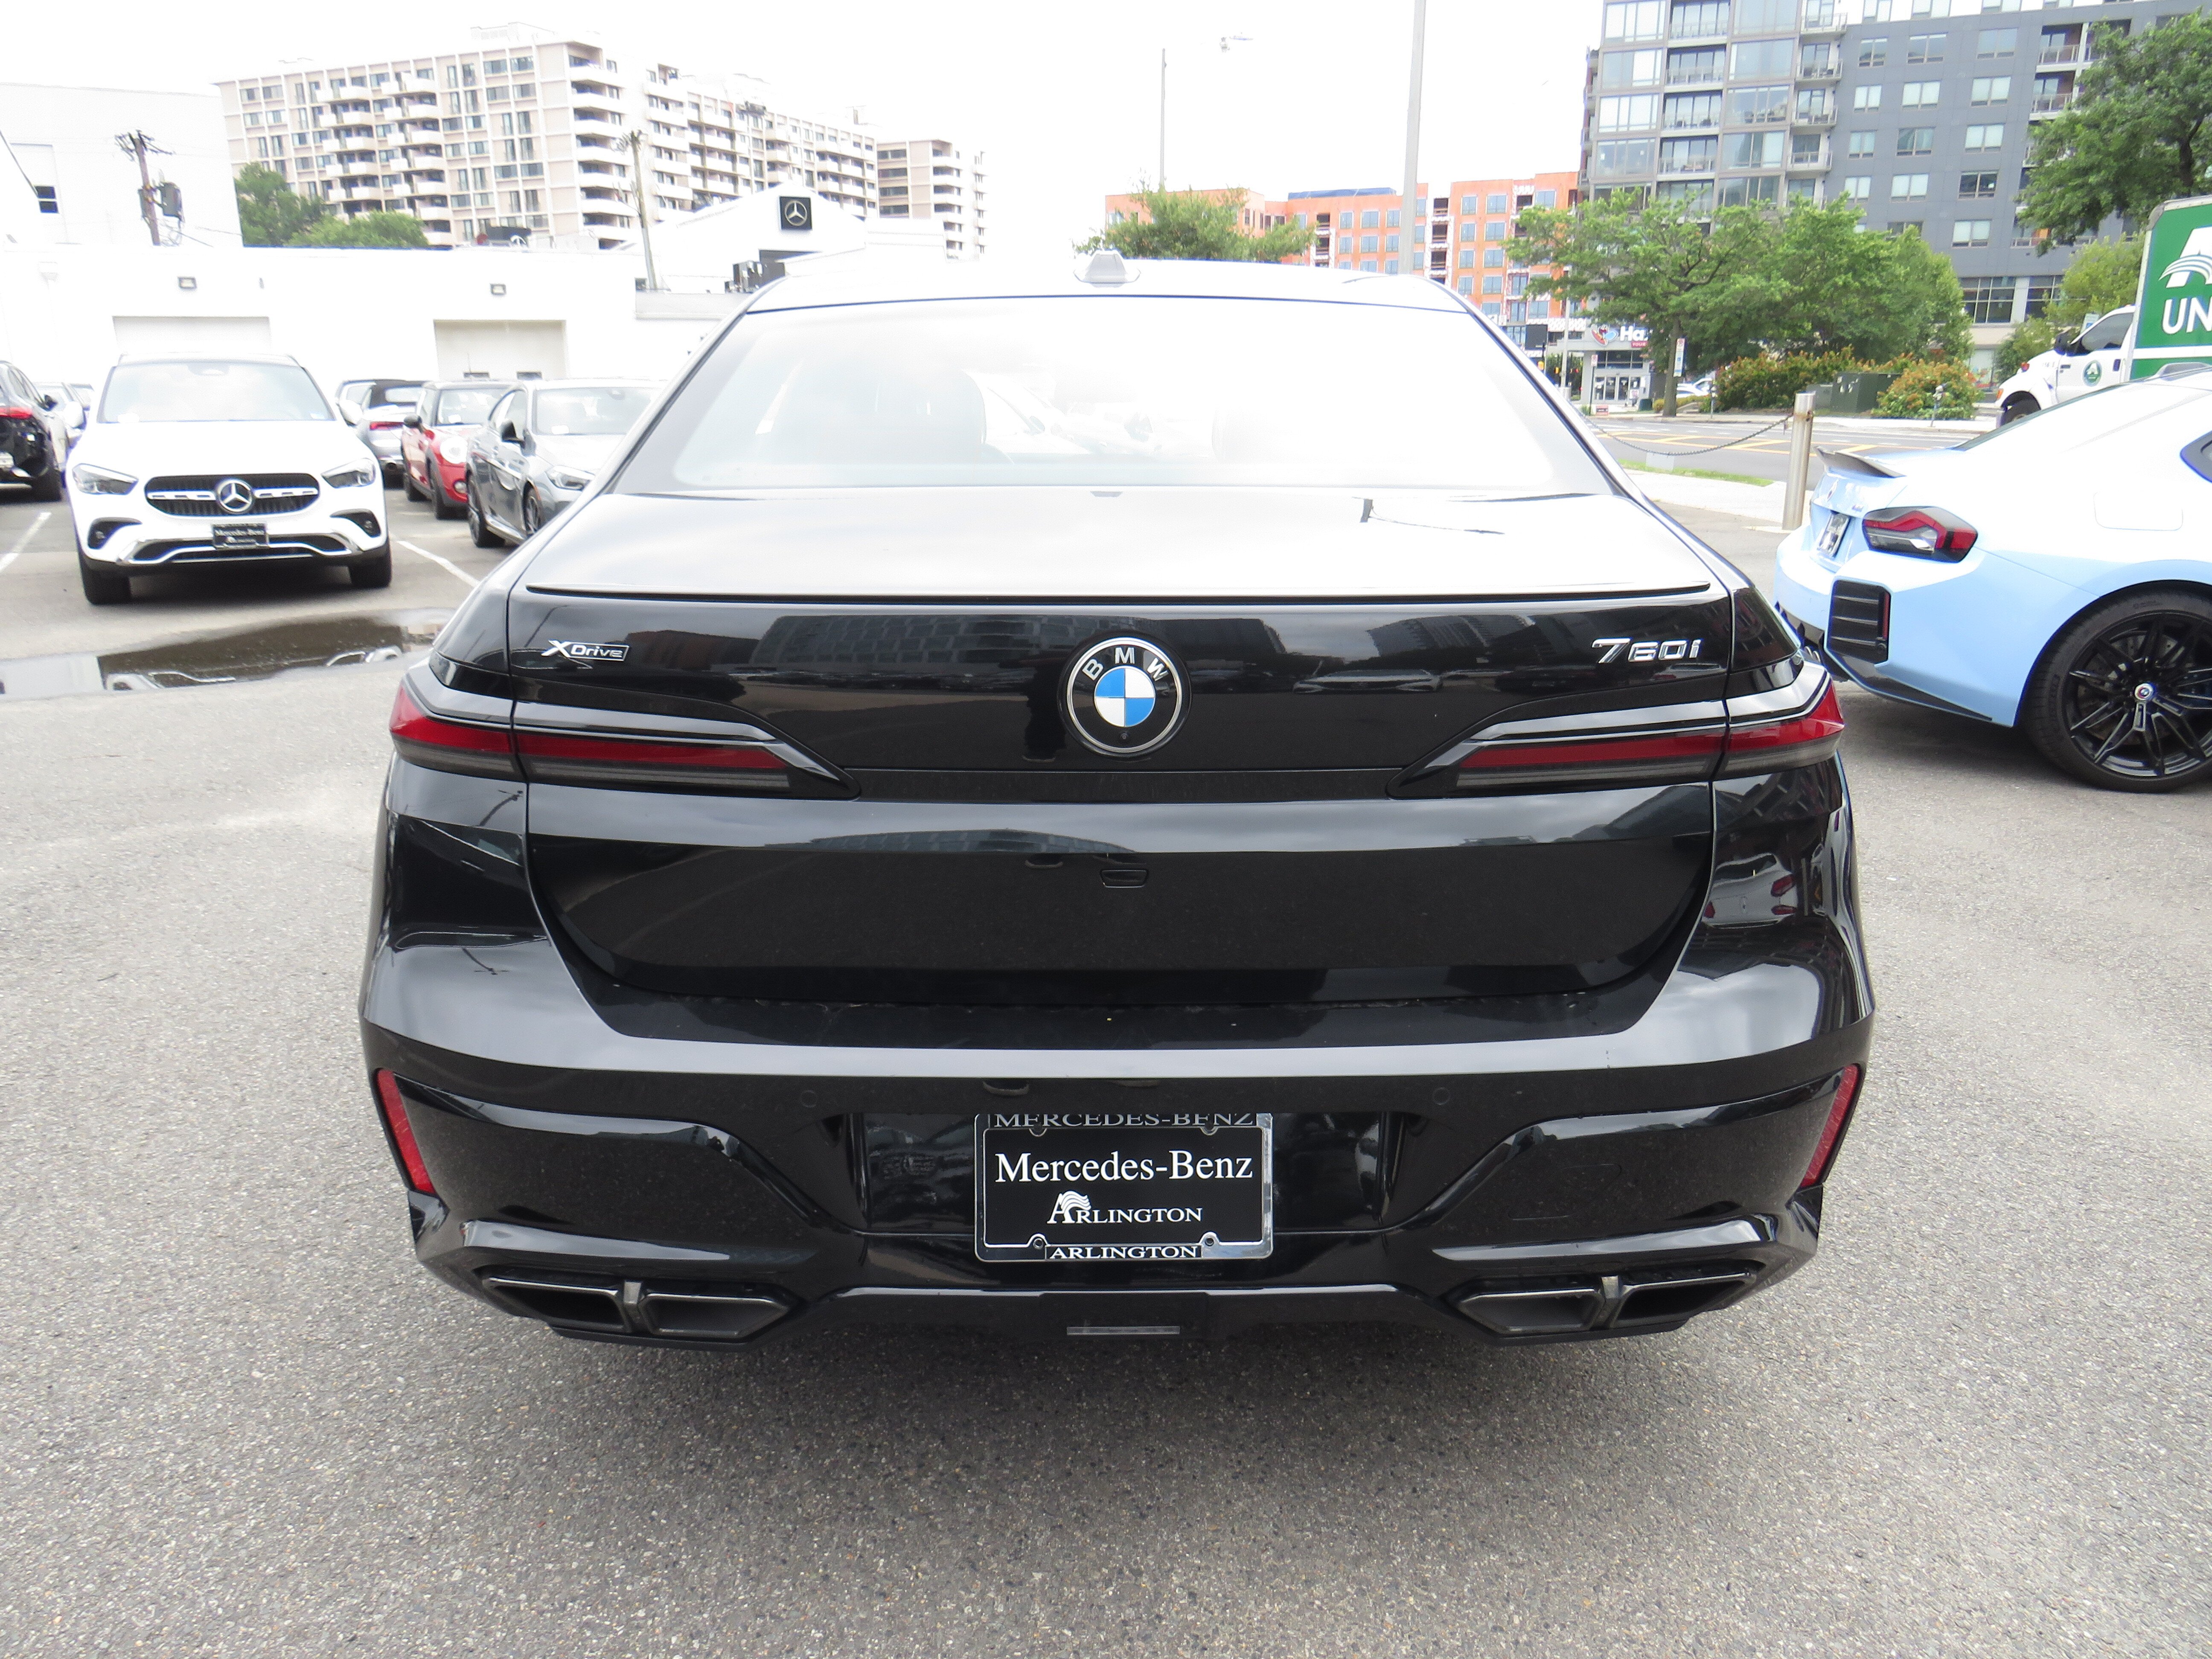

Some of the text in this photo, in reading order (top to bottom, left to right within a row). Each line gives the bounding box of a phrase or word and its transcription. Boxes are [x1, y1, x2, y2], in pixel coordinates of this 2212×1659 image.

[1620, 326, 1648, 341] Ha
[1082, 647, 1169, 681] BMW
[1592, 637, 1702, 664] 760i
[995, 1150, 1253, 1182] Mercedes-Benz
[1047, 1190, 1202, 1224] ARLINGTON
[1050, 1246, 1198, 1259] ARLINGTON
